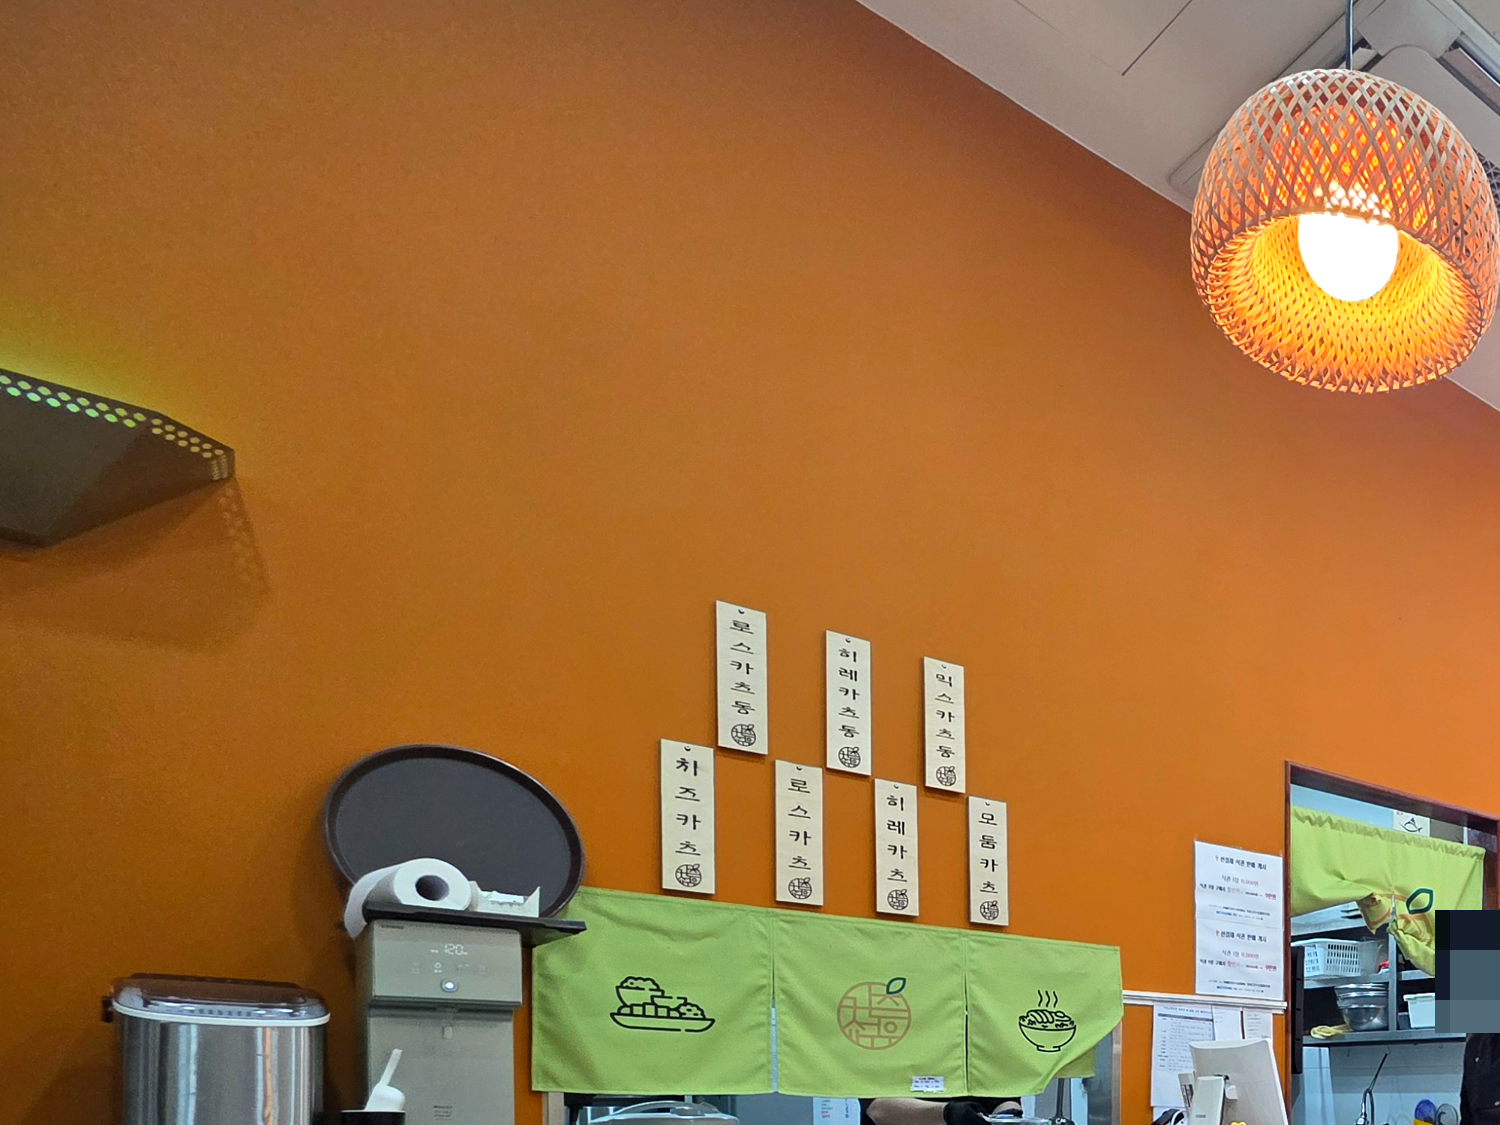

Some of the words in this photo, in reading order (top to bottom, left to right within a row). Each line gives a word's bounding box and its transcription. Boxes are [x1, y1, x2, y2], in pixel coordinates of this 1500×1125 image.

[730, 620, 755, 714] 로스카츠동
[838, 648, 859, 738] 히레카츠동
[935, 673, 955, 759] 믹스카츠동
[675, 758, 701, 856] 치즈카츠
[788, 779, 811, 870] 로스카츠
[887, 796, 908, 882] 히레카츠
[979, 813, 998, 893] 모둠카츠
